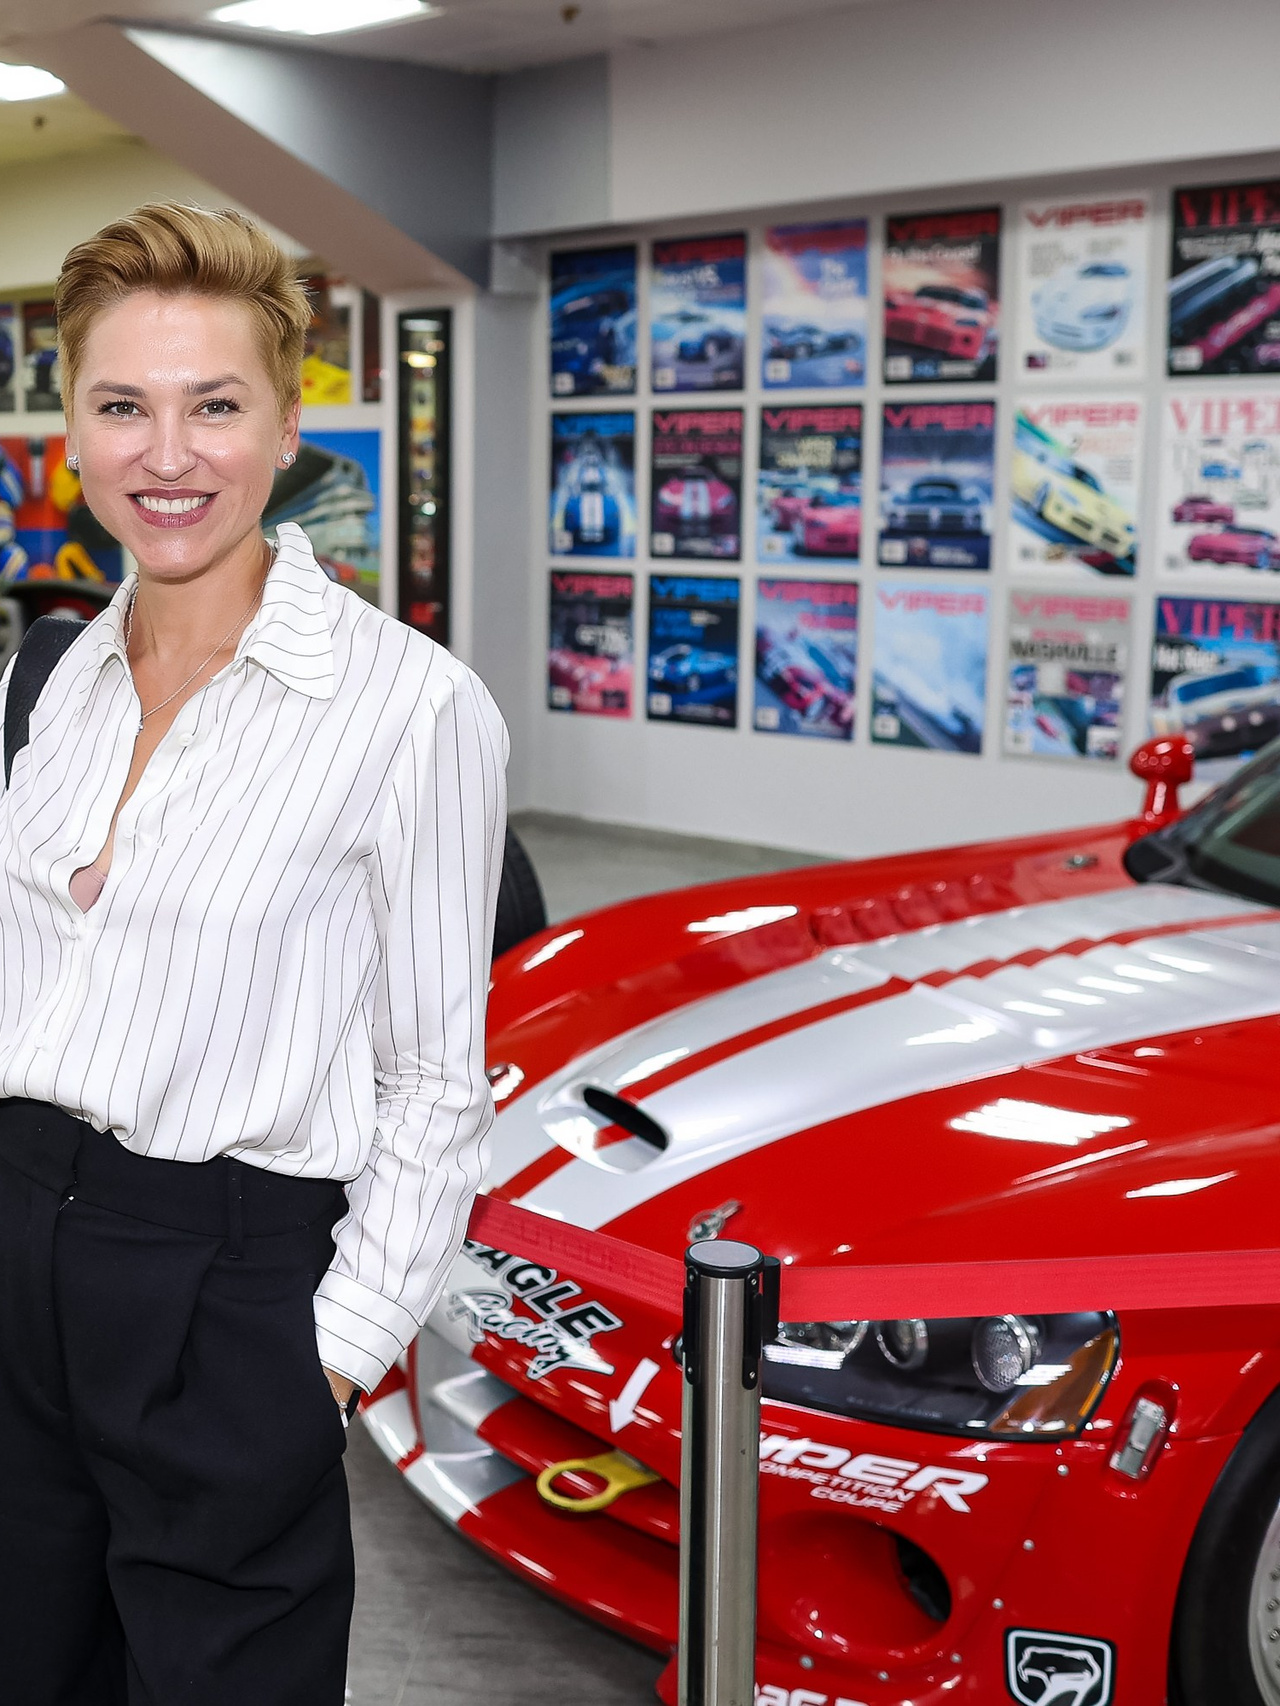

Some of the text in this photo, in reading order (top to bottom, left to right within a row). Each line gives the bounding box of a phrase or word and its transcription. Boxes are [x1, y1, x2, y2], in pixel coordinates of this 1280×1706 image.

[890, 211, 1000, 240] VIPER
[1026, 199, 1146, 228] VIPER
[654, 412, 743, 434] VIPER
[763, 408, 861, 432] VIPER
[884, 406, 994, 430] VIPER
[1027, 402, 1139, 425] VIPER
[553, 575, 633, 597] VIPER
[652, 578, 739, 601] VIPER
[759, 583, 858, 606] VIPER
[877, 590, 987, 617] VIPER
[1011, 594, 1131, 623] VIPER
[463, 1240, 623, 1343] AGLE
[760, 1432, 989, 1513] IPER
[760, 1461, 916, 1502] OMPETITION
[809, 1485, 905, 1514] COUPE
